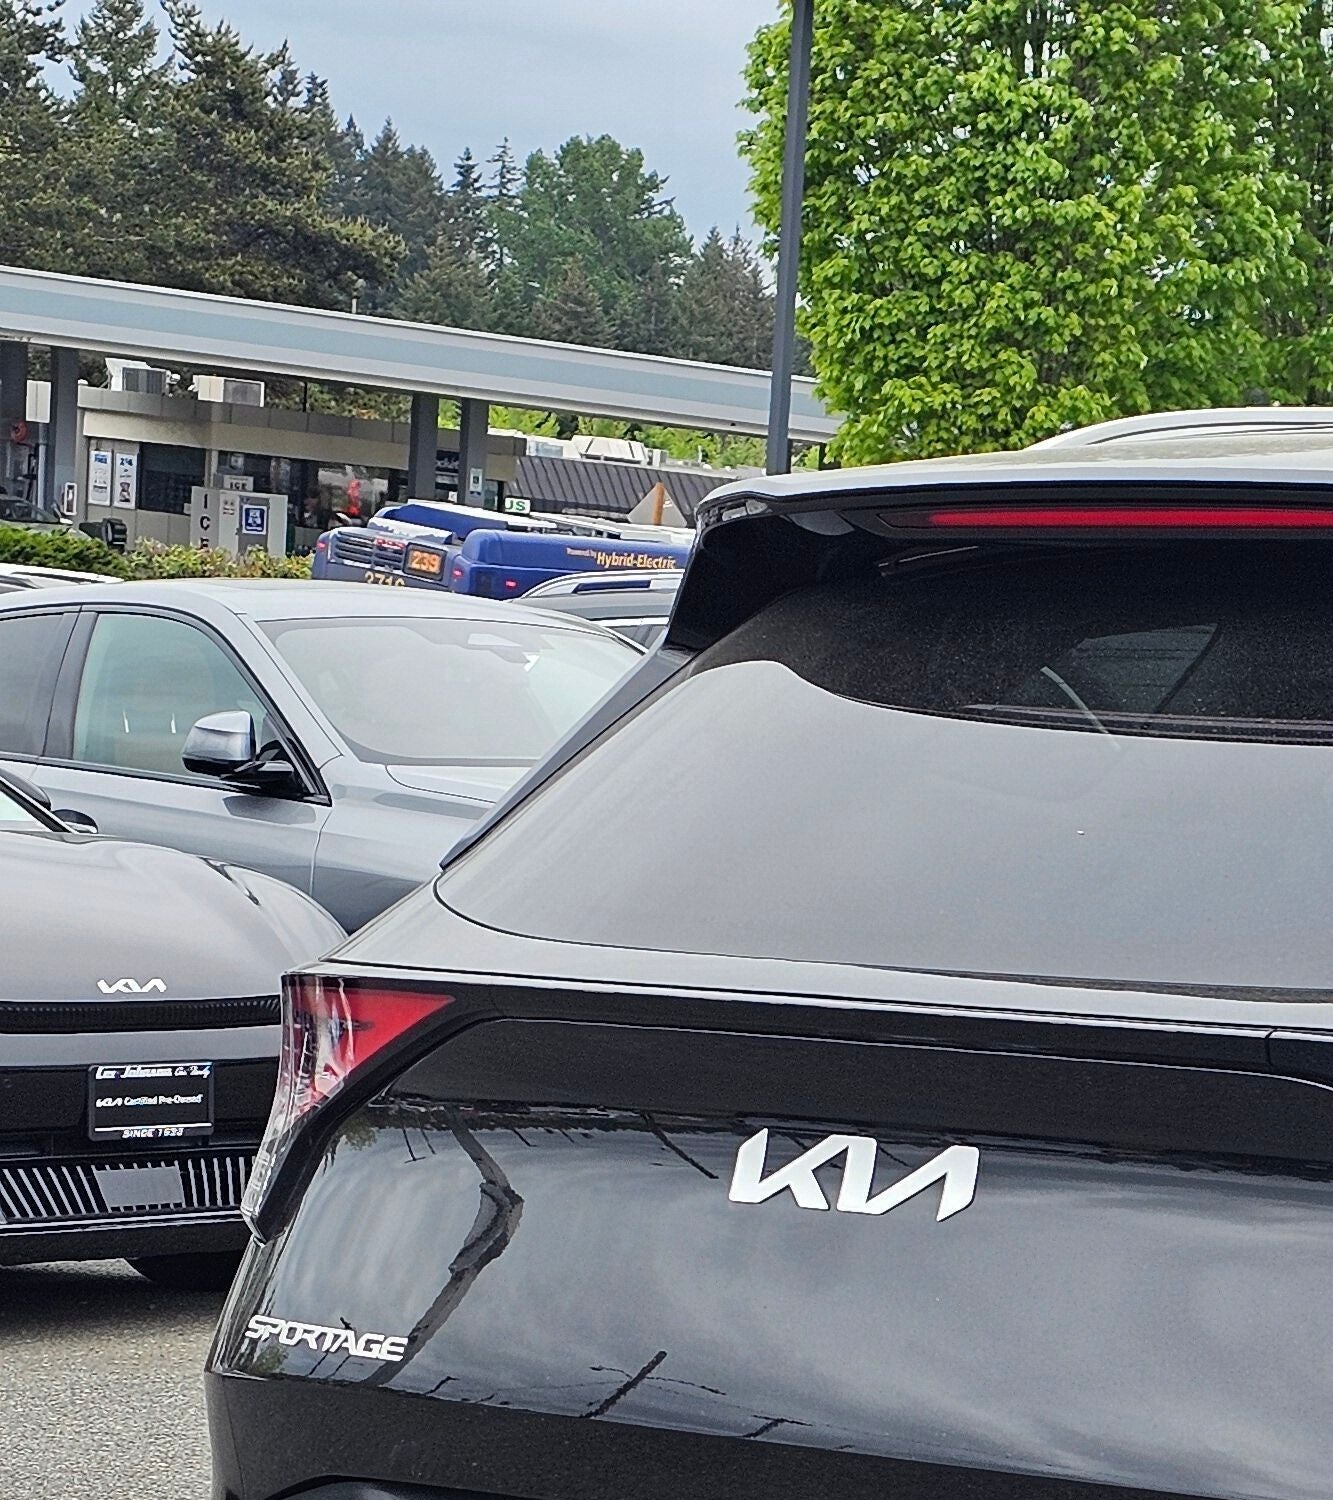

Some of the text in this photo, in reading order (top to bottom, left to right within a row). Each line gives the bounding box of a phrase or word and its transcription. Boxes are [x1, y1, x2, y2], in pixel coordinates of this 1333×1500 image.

[596, 552, 676, 569] Hybrid-Electric
[122, 1128, 156, 1138] SINCE
[728, 1127, 980, 1222] KIA
[244, 1314, 409, 1362] SPORTAGE
